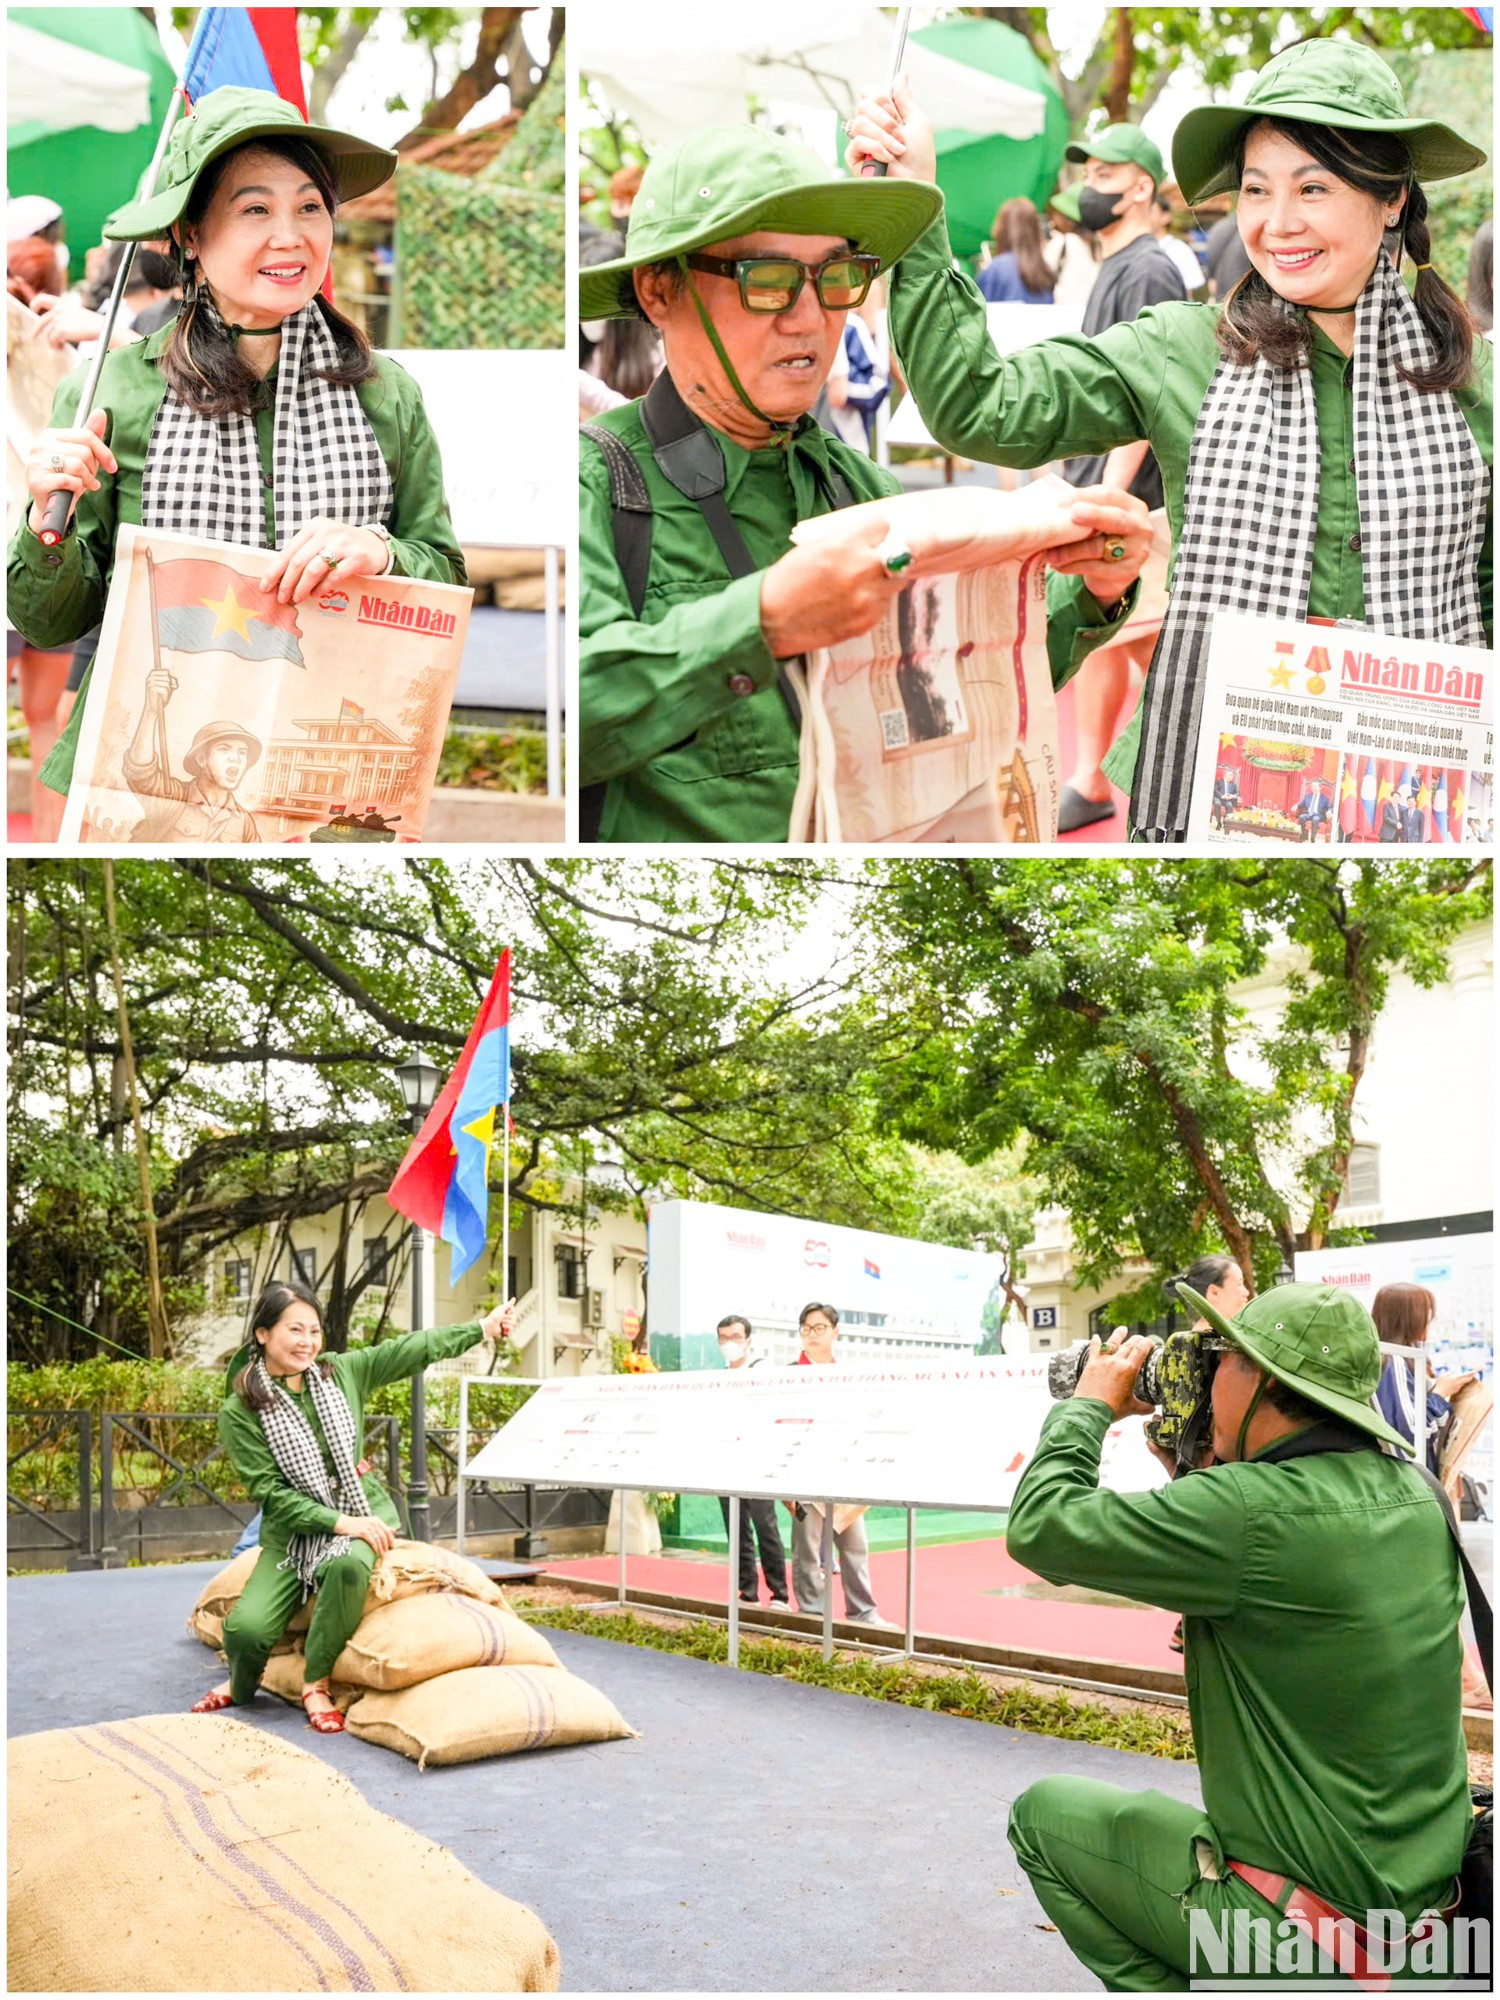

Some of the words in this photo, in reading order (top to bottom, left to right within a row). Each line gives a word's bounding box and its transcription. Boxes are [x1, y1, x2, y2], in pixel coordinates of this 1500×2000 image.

[358, 595, 415, 626] Nhân
[415, 606, 456, 634] Dân
[1341, 649, 1420, 691] Nhân
[1424, 661, 1484, 701] Dân
[1232, 712, 1239, 726] và
[1240, 713, 1248, 727] EU
[1248, 715, 1262, 729] phát
[1262, 715, 1277, 731] triển
[1277, 719, 1291, 736] thực
[1306, 724, 1320, 741] hiệu
[1320, 724, 1332, 740] quả
[1237, 696, 1252, 709] quan
[1252, 697, 1260, 713] hệ
[1260, 698, 1273, 712] giữa
[1274, 700, 1286, 715] Việt
[1286, 702, 1300, 716] Nam
[1300, 704, 1310, 718] với
[1310, 705, 1343, 723] Philippines
[1357, 710, 1368, 727] Dấu
[1369, 712, 1381, 729] mốc
[1382, 718, 1396, 731] quan
[1397, 719, 1414, 735] trọng
[1414, 722, 1427, 737] thúc
[1428, 721, 1439, 739] đẩy
[1440, 727, 1455, 740] quan
[1455, 727, 1463, 744] hệ
[1347, 729, 1359, 747] Việt
[1385, 736, 1392, 750] đi
[1393, 737, 1403, 752] vào
[1404, 737, 1420, 755] chiều
[1421, 741, 1432, 756] sâu
[1432, 743, 1440, 757] và
[1455, 746, 1468, 763] thực
[1036, 1308, 1053, 1326] B
